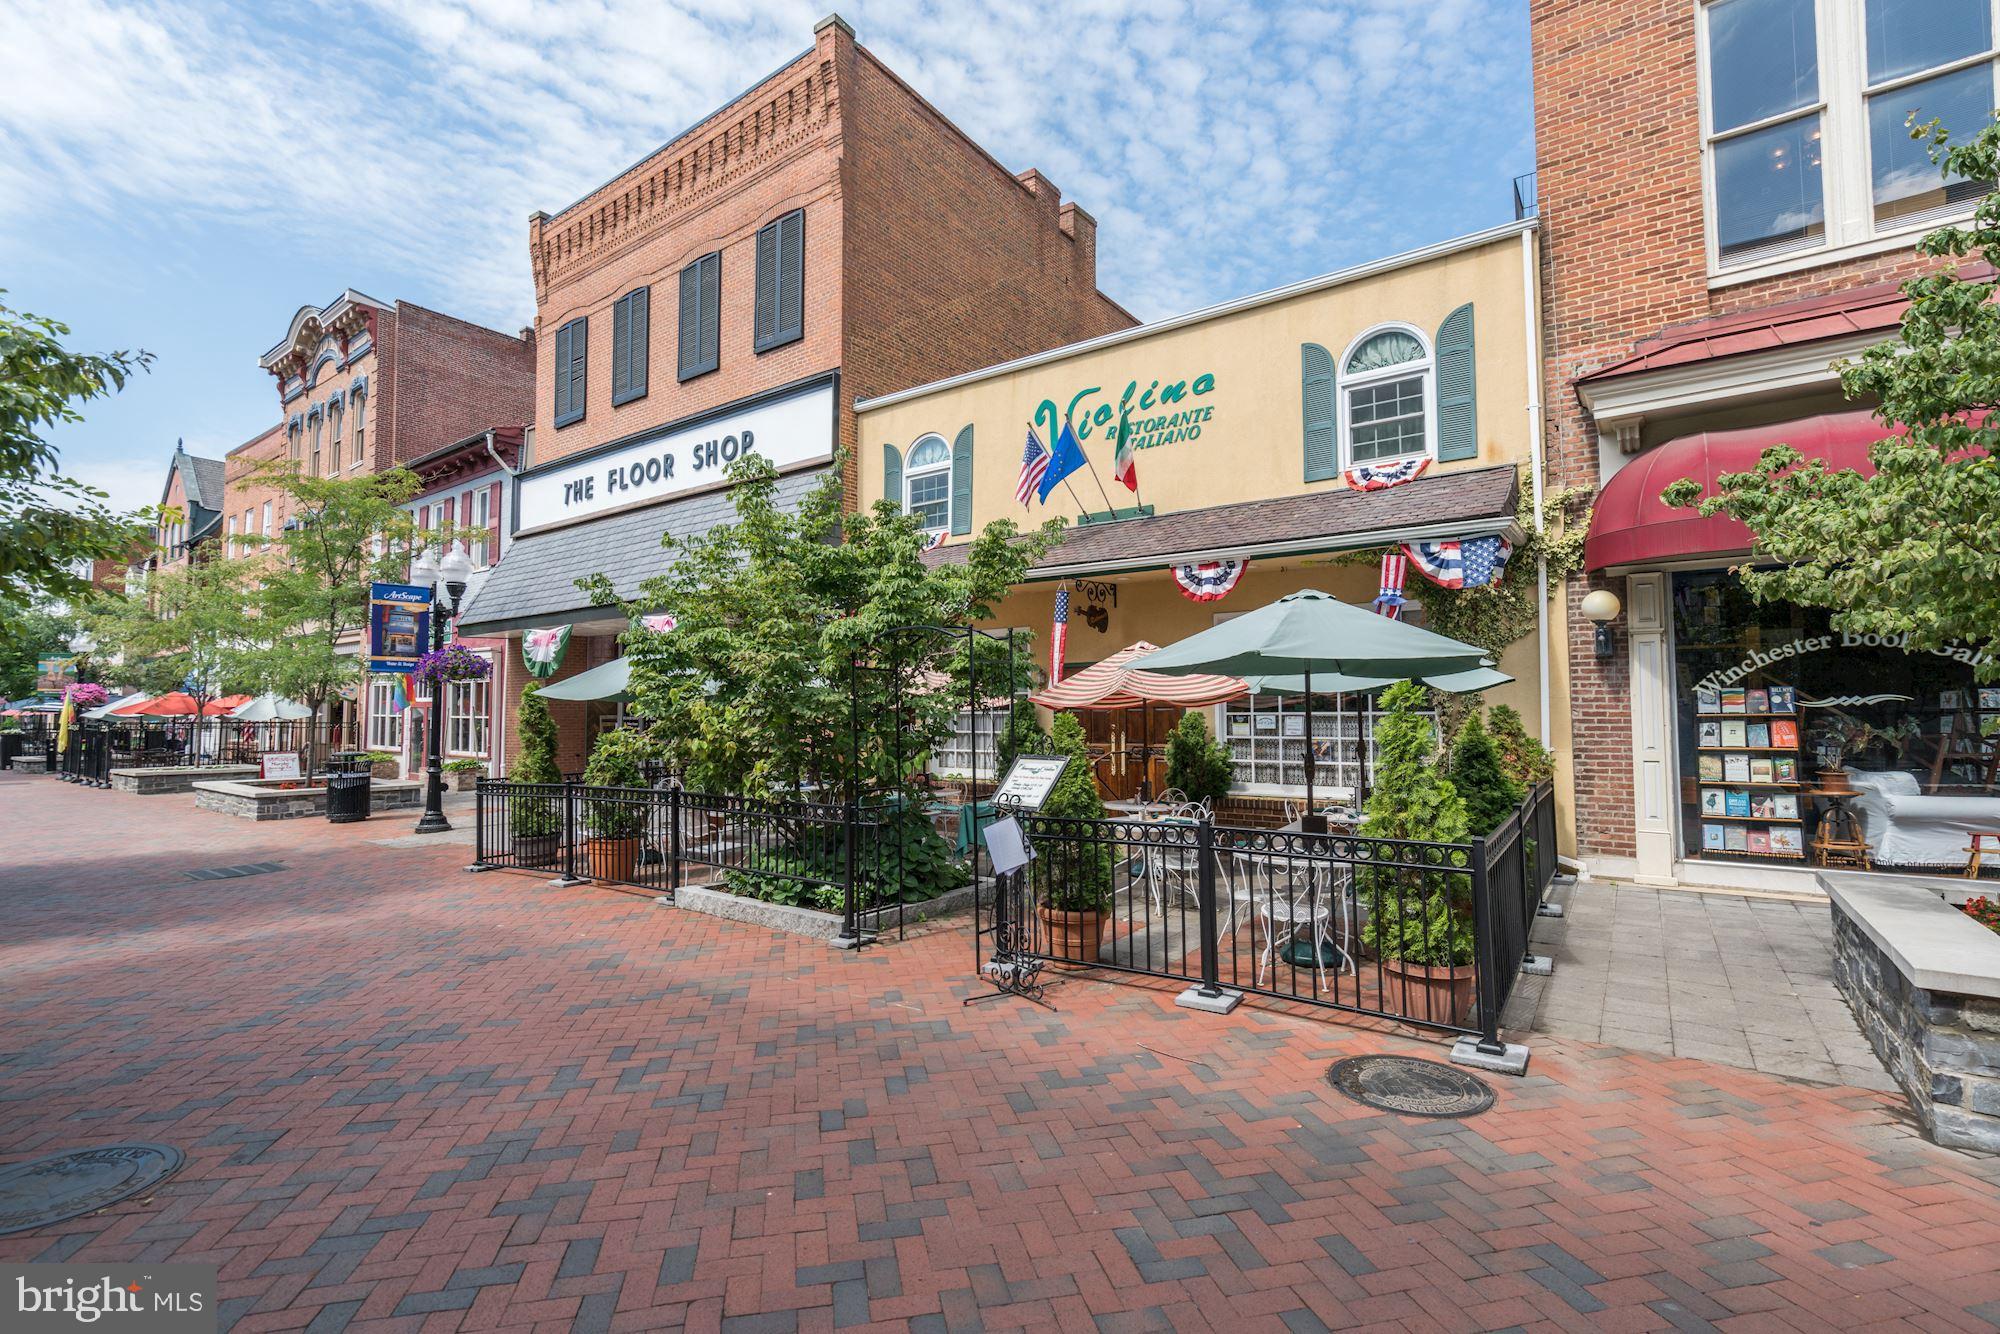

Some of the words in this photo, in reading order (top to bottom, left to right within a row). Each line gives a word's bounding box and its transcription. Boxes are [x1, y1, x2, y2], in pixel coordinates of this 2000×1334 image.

[1035, 373, 1215, 451] Violino
[1131, 425, 1202, 451] TALIANO
[564, 476, 594, 506] THE
[607, 453, 675, 494] FLOOR
[693, 430, 755, 470] SHOP
[383, 590, 422, 602] ArtScape
[1692, 635, 1832, 697] Winchester
